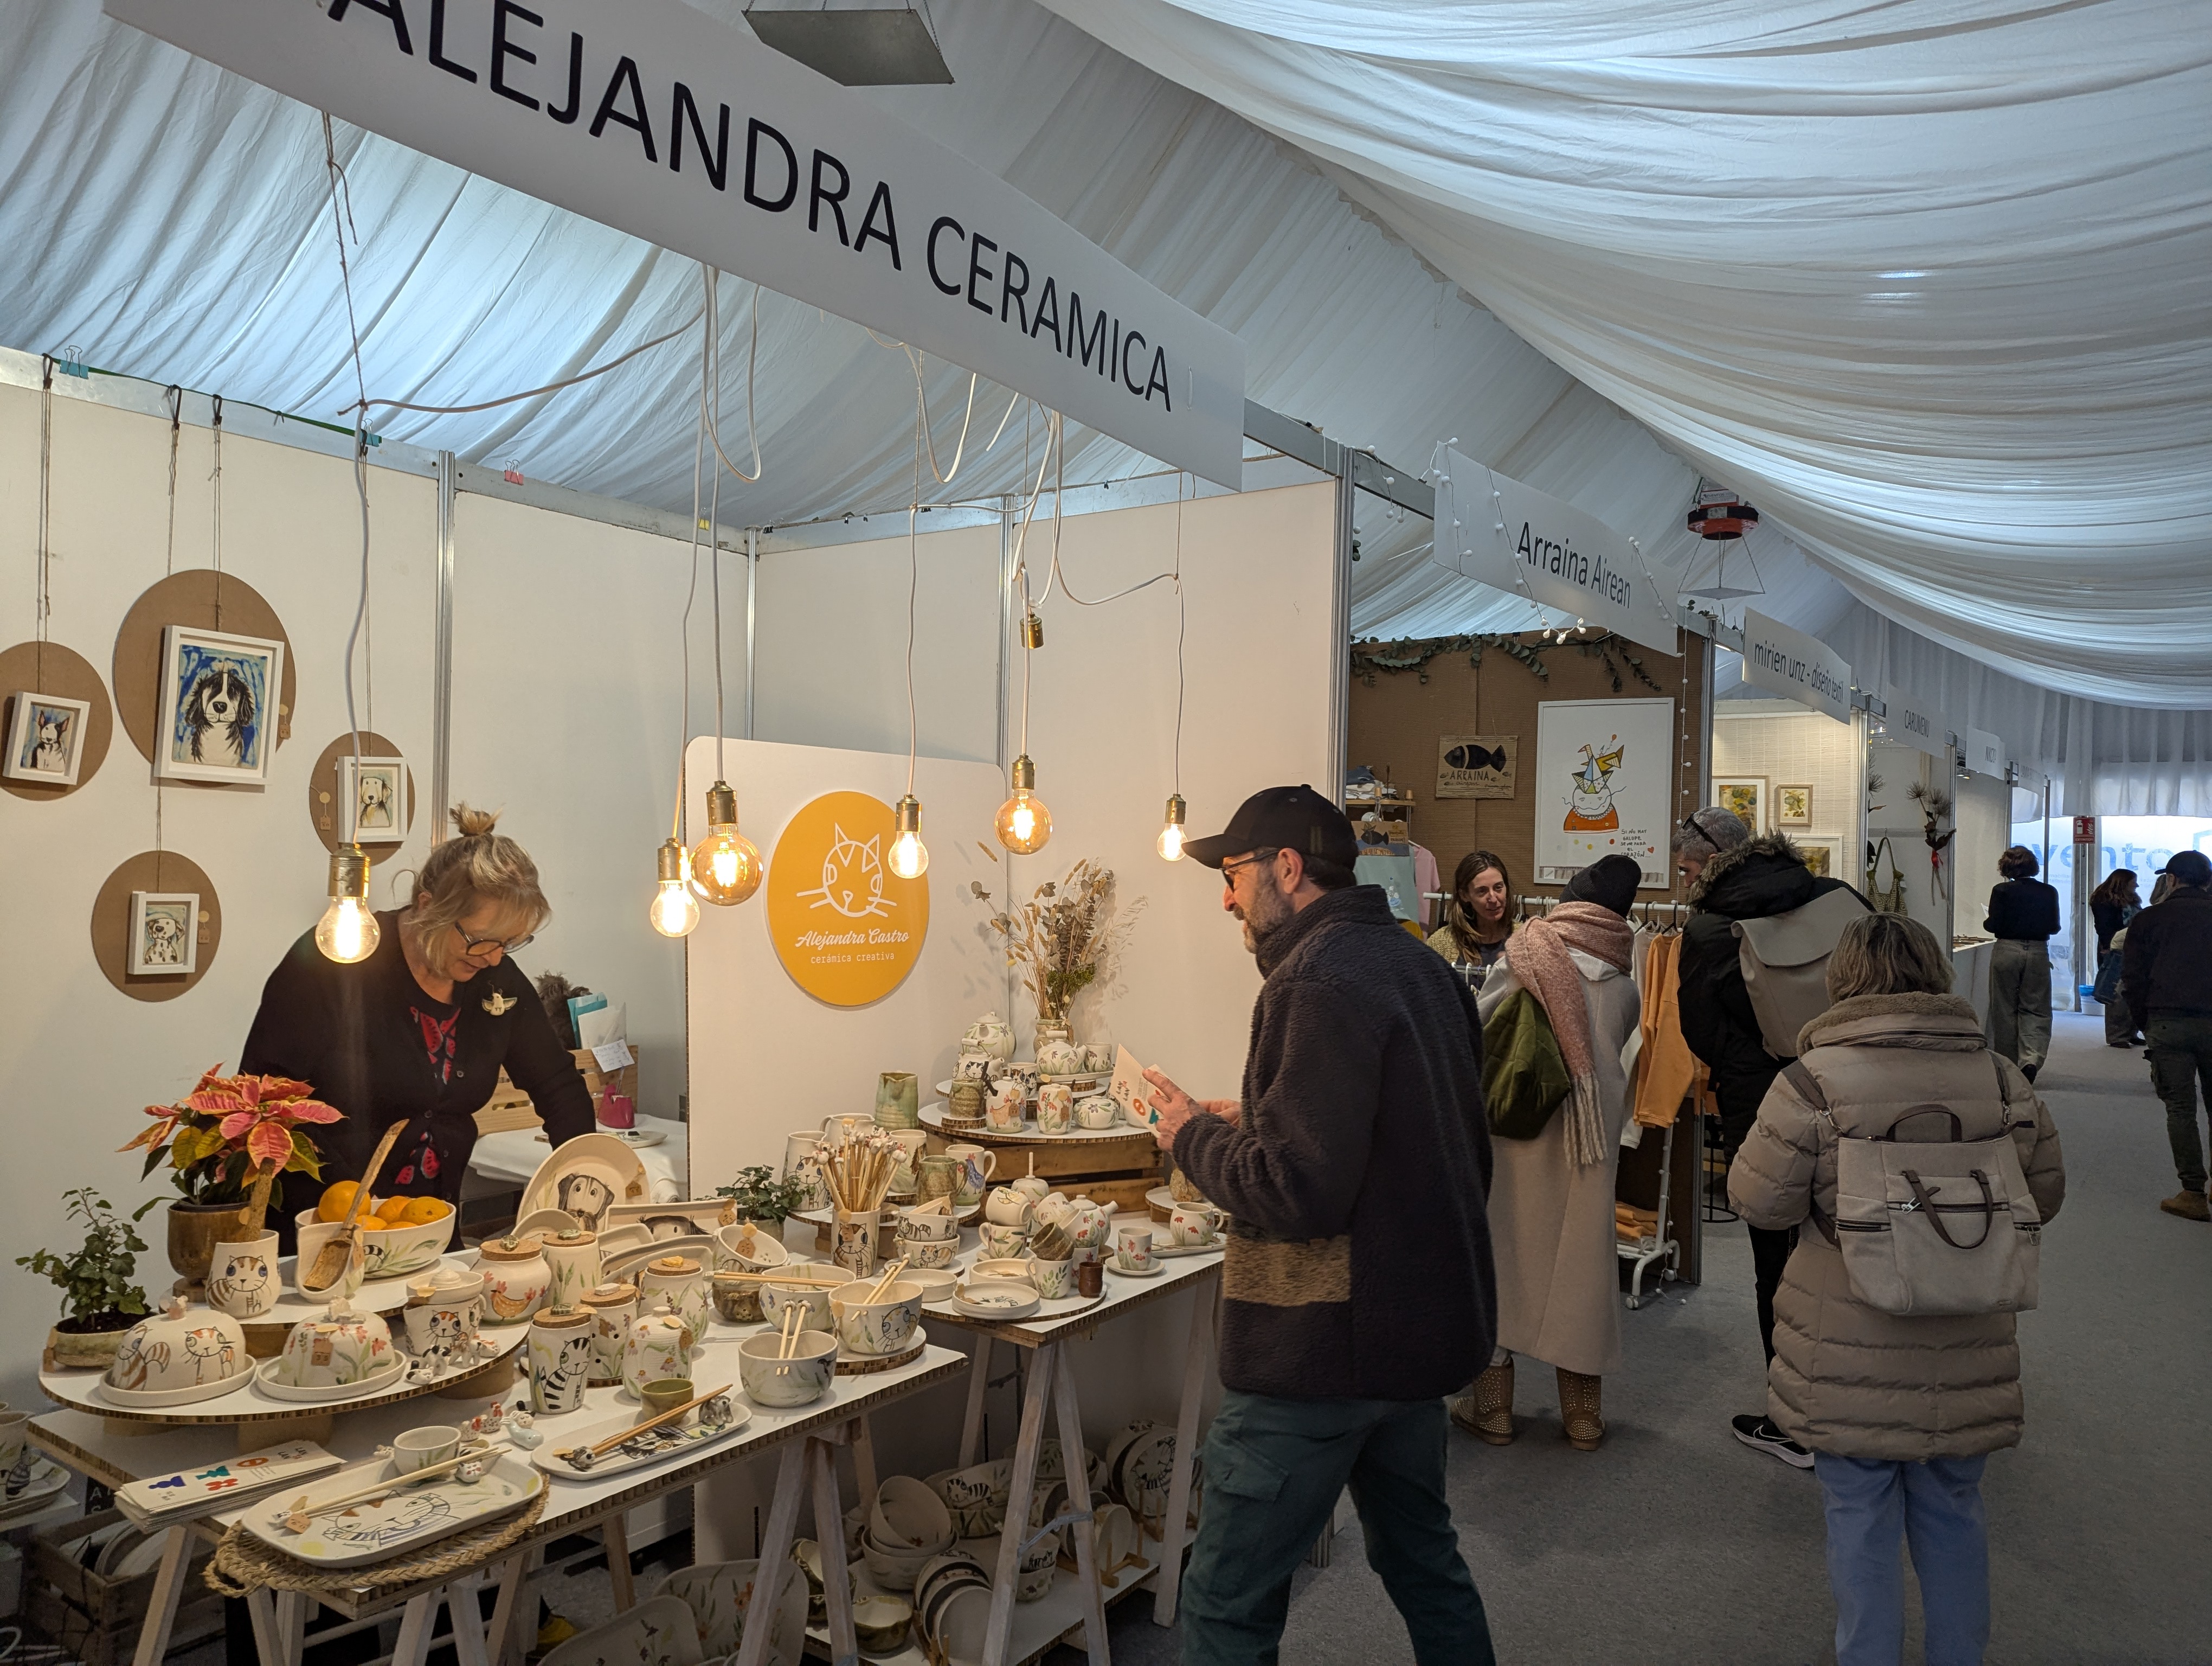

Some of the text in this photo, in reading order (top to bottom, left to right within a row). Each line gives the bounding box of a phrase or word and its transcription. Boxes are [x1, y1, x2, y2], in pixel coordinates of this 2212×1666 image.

[926, 216, 1172, 412] CERAMICA
[1517, 521, 1631, 610] Arraina Airean
[1754, 640, 1786, 675] mirien
[1789, 658, 1806, 682] unz
[1811, 662, 1831, 696] diseño
[1831, 676, 1844, 704] textil
[1449, 770, 1489, 781] ARRAINA
[795, 927, 910, 951] Alejandra Castro
[811, 951, 895, 964] cerámica creativa
